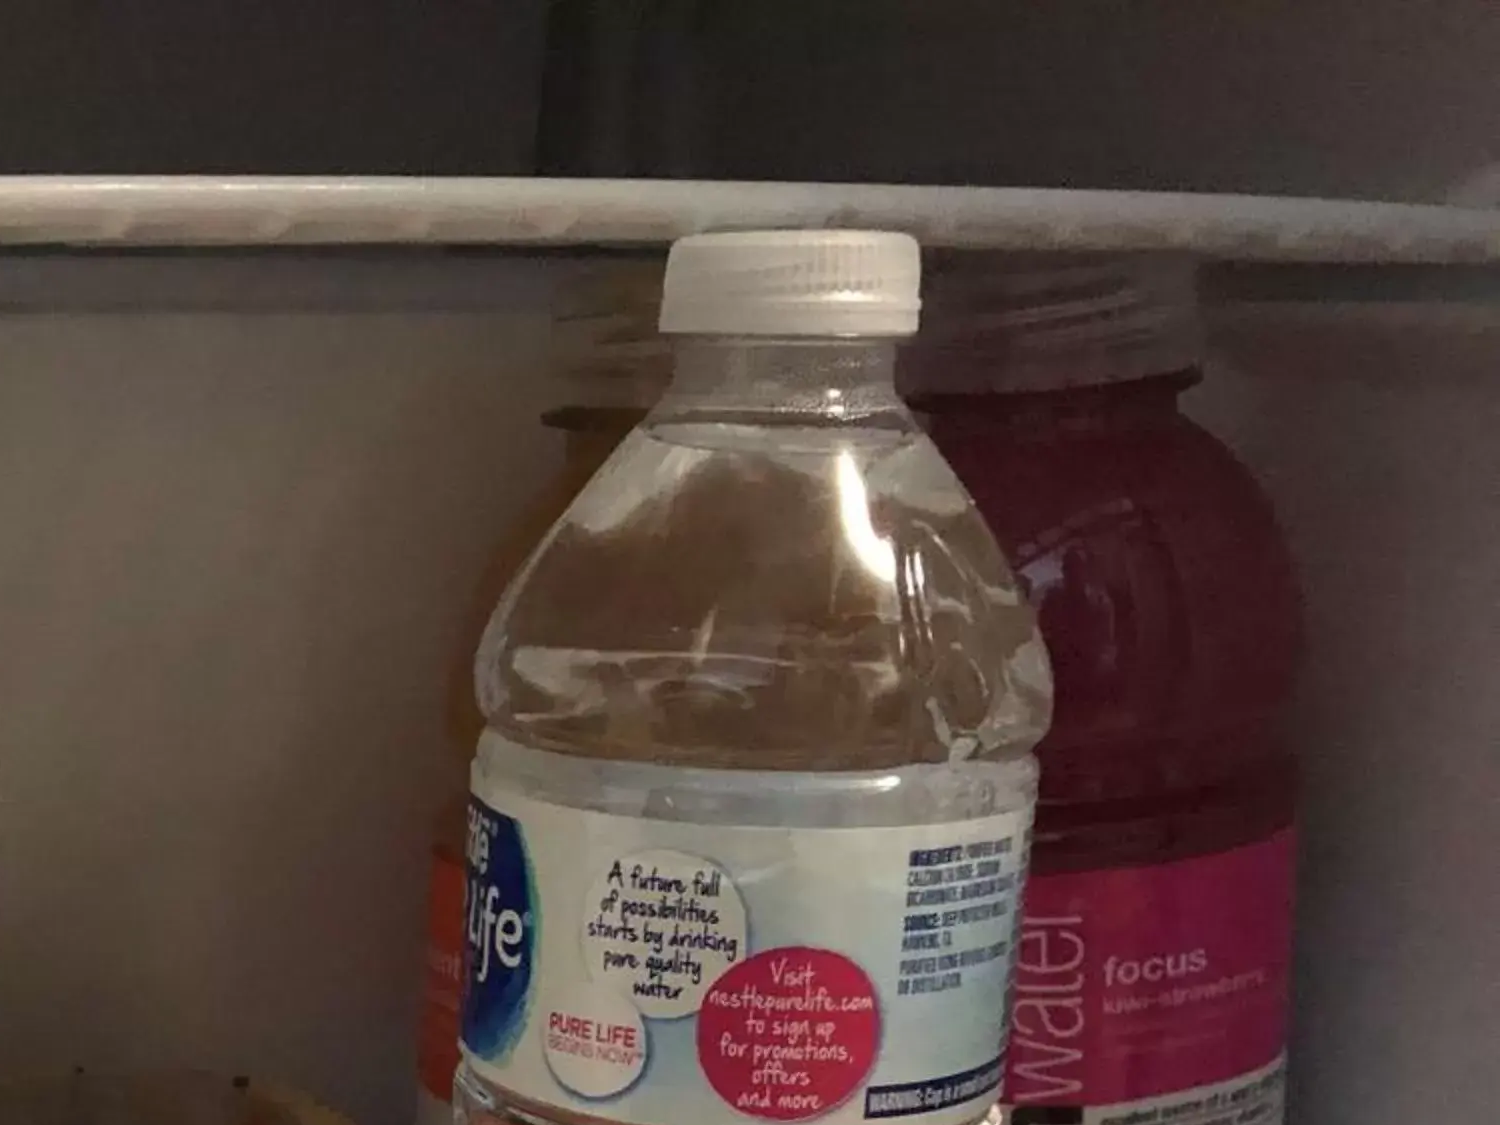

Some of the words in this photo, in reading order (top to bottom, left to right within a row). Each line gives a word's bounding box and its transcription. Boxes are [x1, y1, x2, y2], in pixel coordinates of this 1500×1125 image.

[607, 860, 624, 888] A
[630, 864, 687, 893] future
[692, 868, 722, 897] full
[600, 889, 619, 913] of
[621, 896, 719, 925] possibilities
[587, 916, 639, 943] starts
[643, 924, 664, 954] by
[668, 924, 738, 962] drinking
[603, 949, 641, 971] pure
[645, 950, 703, 985] quality
[769, 957, 816, 990] Visit
[1103, 948, 1208, 988] focus
[633, 979, 683, 1001] water
[709, 982, 874, 1017] nestlepurelife.com
[550, 1012, 593, 1040] PURE
[596, 1023, 637, 1049] LIFE
[745, 1010, 766, 1035] to
[772, 1014, 810, 1045] sign
[815, 1021, 837, 1043] up
[720, 1031, 749, 1057] for
[753, 1037, 854, 1066] promotions,
[752, 1061, 811, 1086] offers
[737, 1086, 772, 1108] and
[777, 1094, 821, 1110] more
